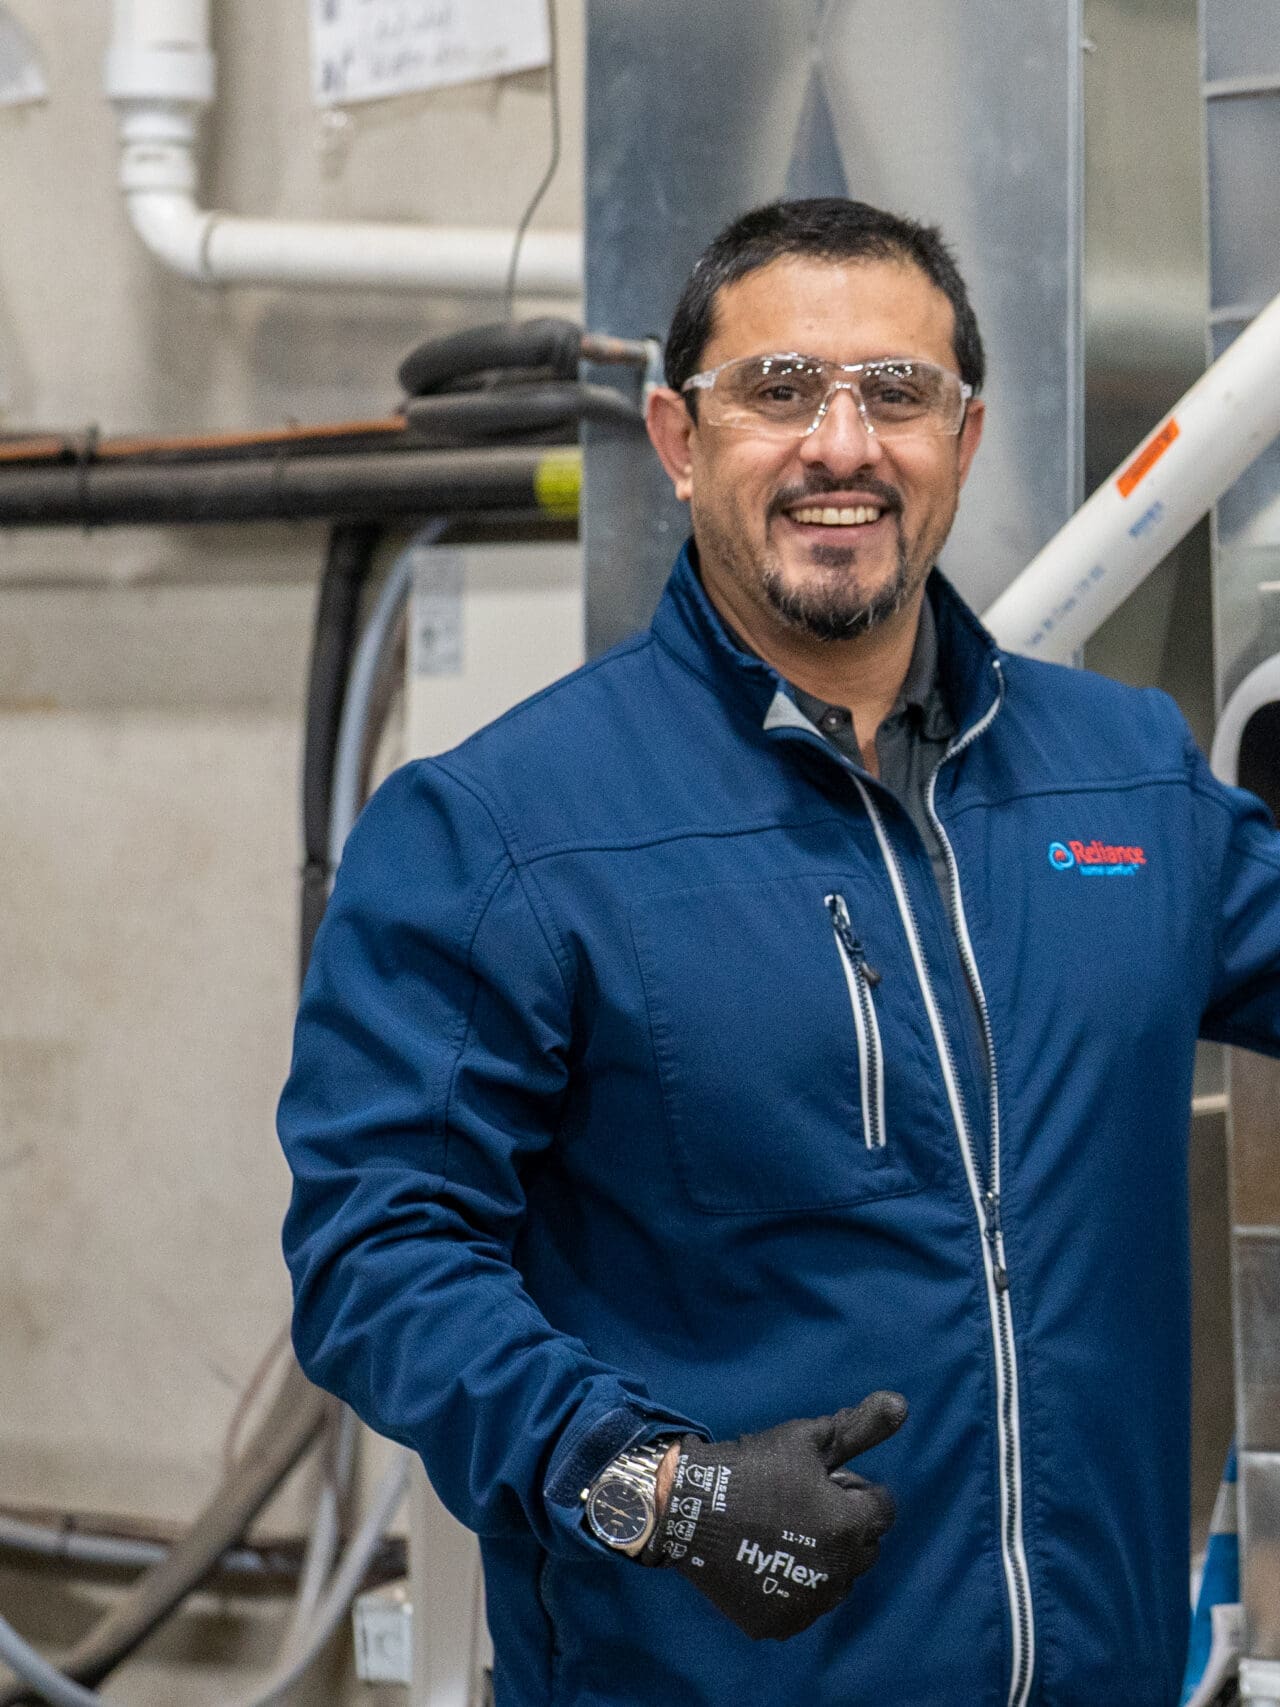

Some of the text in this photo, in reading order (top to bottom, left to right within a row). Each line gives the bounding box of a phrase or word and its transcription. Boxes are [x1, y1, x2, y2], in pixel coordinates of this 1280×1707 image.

[1068, 840, 1147, 864] Reliance
[715, 1466, 732, 1512] Ansell
[781, 1530, 817, 1548] 11-751
